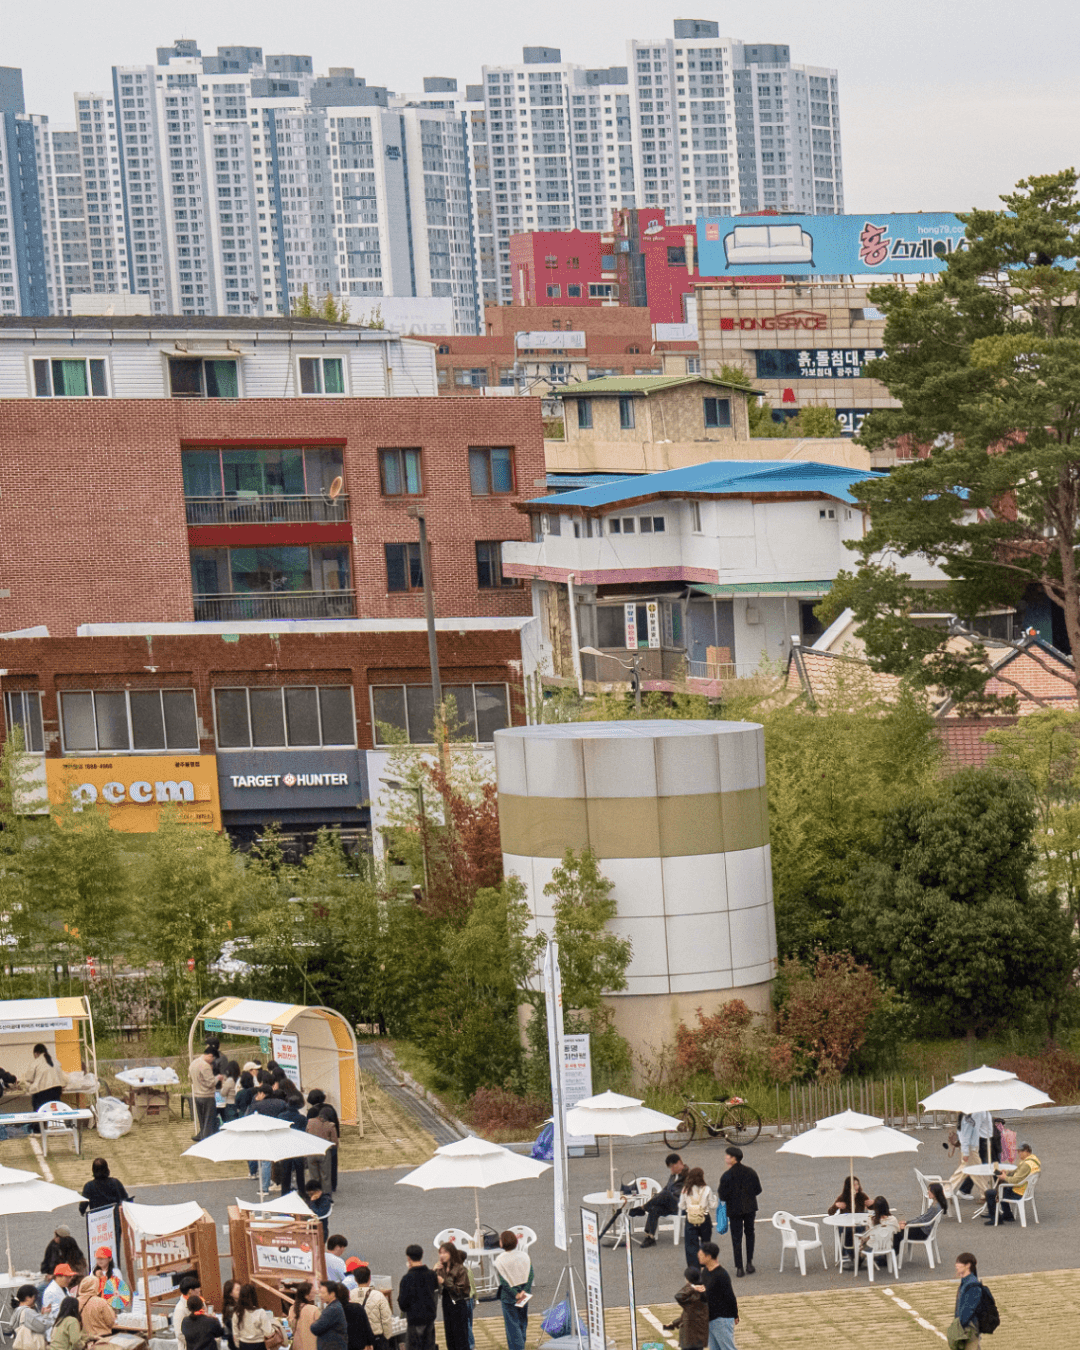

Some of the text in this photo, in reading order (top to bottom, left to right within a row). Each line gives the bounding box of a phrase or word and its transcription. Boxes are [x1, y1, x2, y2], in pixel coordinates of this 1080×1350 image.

[917, 224, 969, 235] hong79.co
[837, 367, 860, 377] 광주점
[230, 772, 349, 788] TARGET HUNTER
[71, 780, 195, 813] pccm
